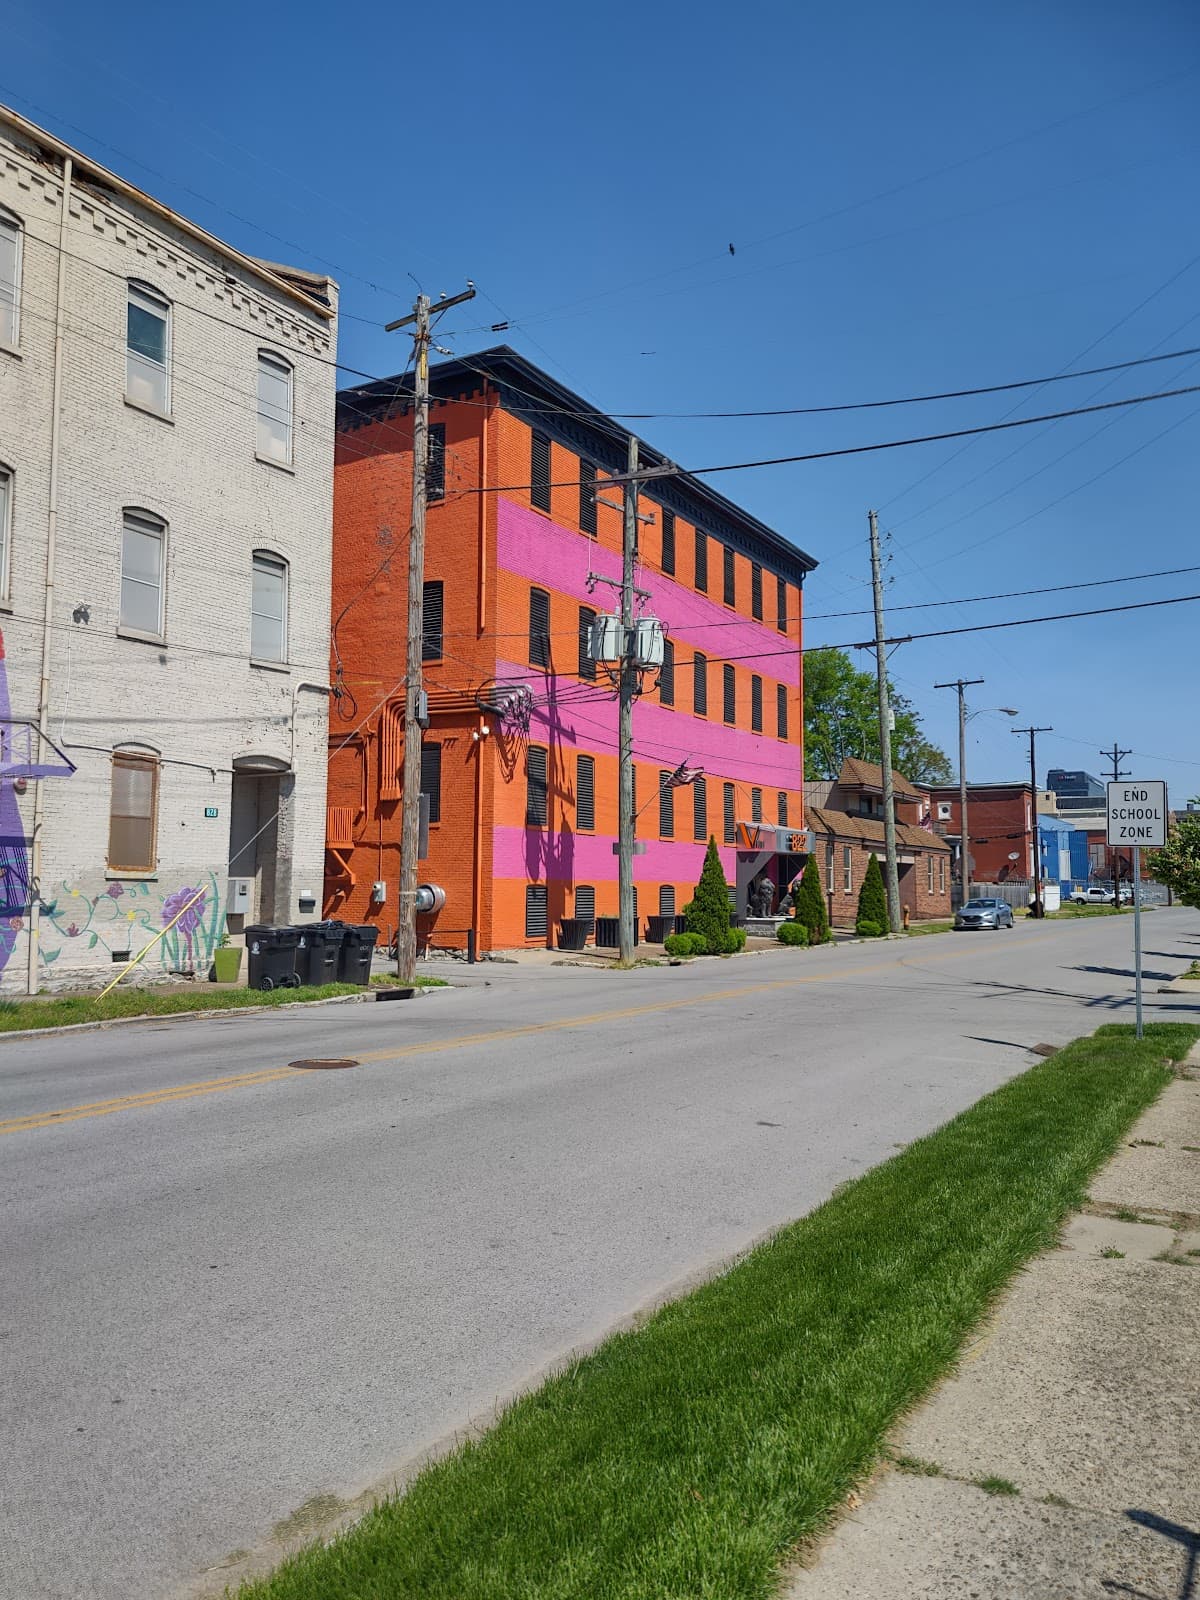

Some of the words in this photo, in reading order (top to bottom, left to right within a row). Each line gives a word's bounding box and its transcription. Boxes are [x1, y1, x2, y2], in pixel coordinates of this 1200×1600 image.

[1124, 790, 1148, 802] END
[1111, 808, 1161, 820] SCHOOL
[1119, 826, 1153, 838] ZONE
